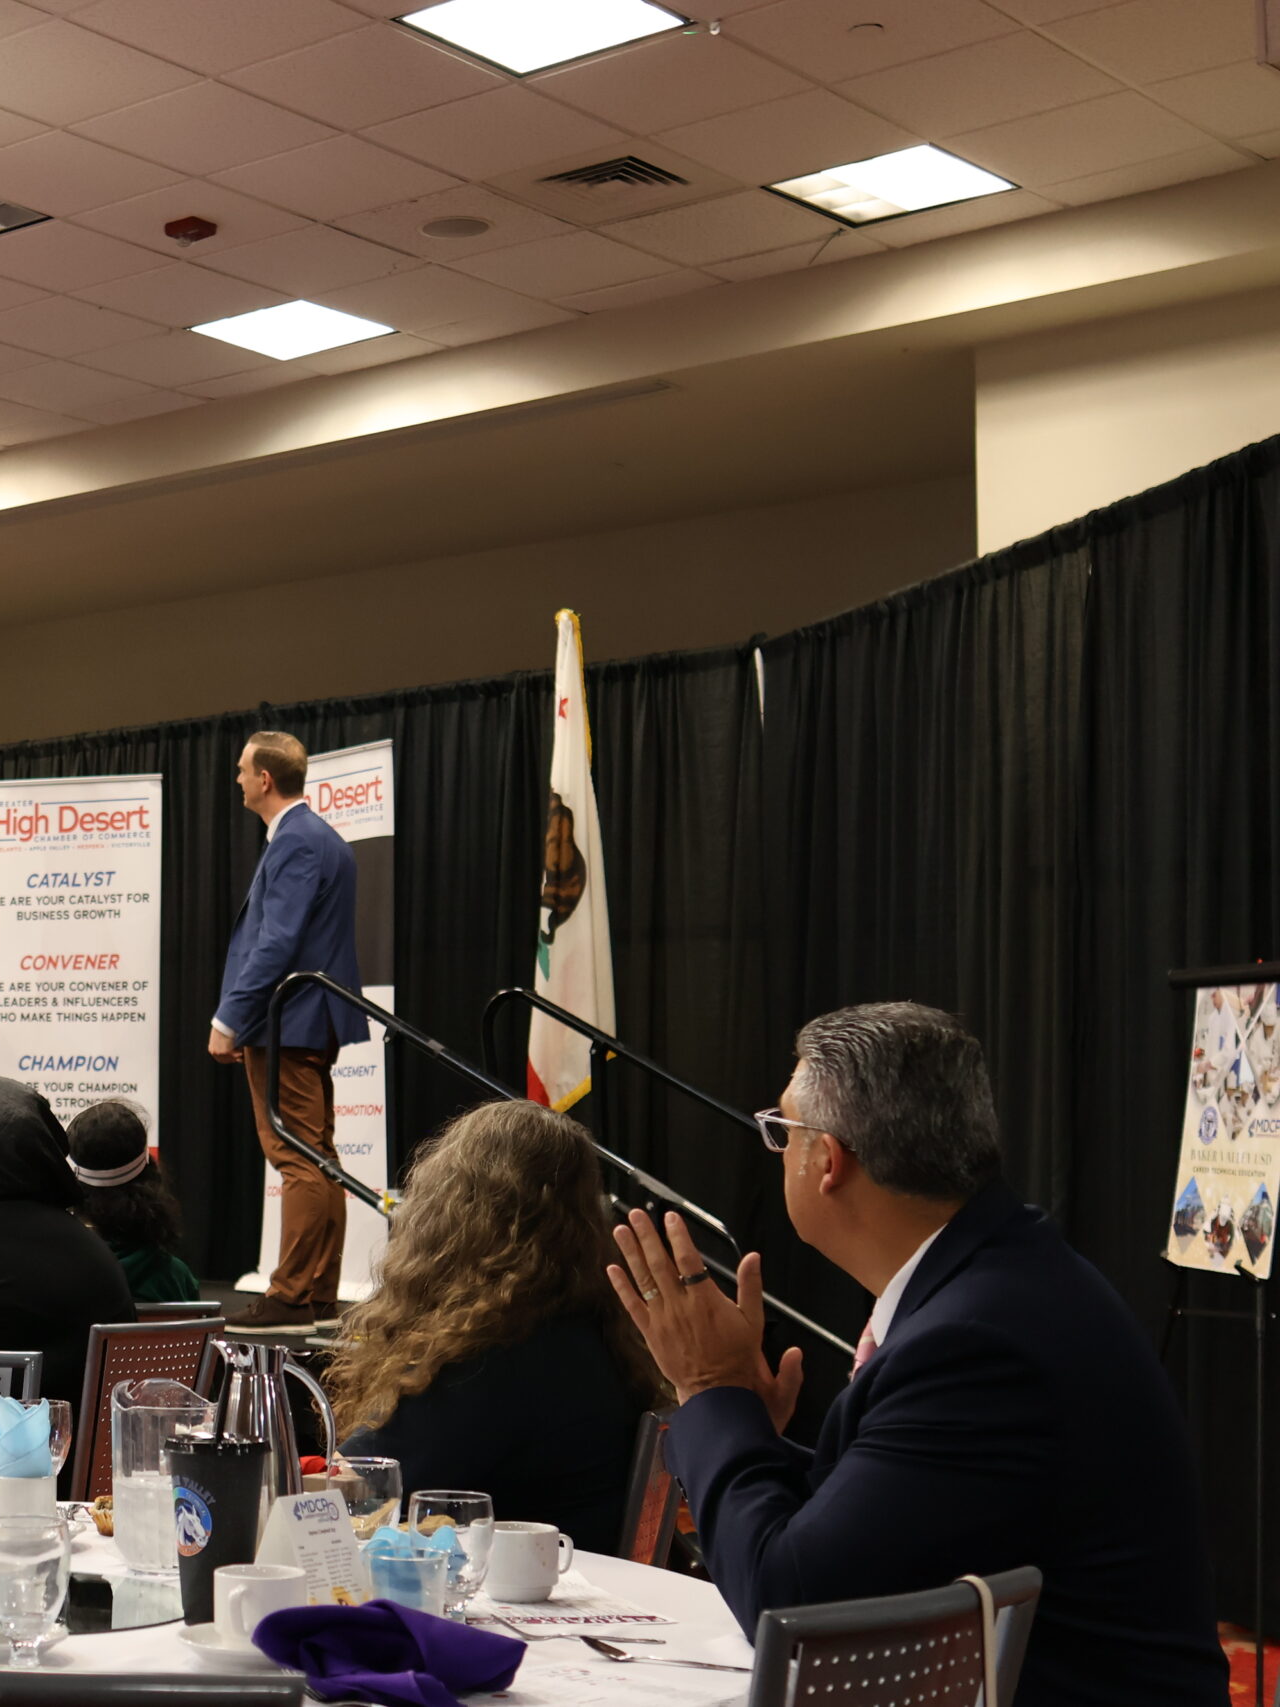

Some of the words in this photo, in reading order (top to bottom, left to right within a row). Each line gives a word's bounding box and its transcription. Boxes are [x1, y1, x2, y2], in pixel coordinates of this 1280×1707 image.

[318, 775, 383, 813] Desert
[58, 805, 150, 834] Desert
[33, 834, 78, 843] CHAMBER
[82, 833, 94, 841] OF
[98, 831, 152, 840] COMMERCE
[26, 871, 116, 888] CATALYST
[9, 896, 32, 907] ARE
[36, 895, 65, 906] YOUR
[69, 893, 123, 905] CATALYST
[127, 892, 150, 903] FOR
[16, 911, 70, 921] BUSINESS
[74, 909, 121, 920] GROWTH
[20, 954, 120, 971] CONVENER
[9, 982, 32, 992] ARE
[35, 982, 65, 992] YOUR
[69, 981, 128, 992] CONVENER
[132, 981, 149, 991] OF
[51, 997, 58, 1007] &
[63, 996, 138, 1007] INFLUENCERS
[20, 1013, 53, 1022] MAKE
[56, 1012, 98, 1022] THINGS
[101, 1012, 146, 1022] HAPPEN
[18, 1055, 119, 1071] CHAMPION
[331, 1064, 378, 1078] ANCEMENT
[43, 1082, 74, 1092] YOUR
[78, 1083, 138, 1093] CHAMPION
[300, 1498, 328, 1514] MDCP
